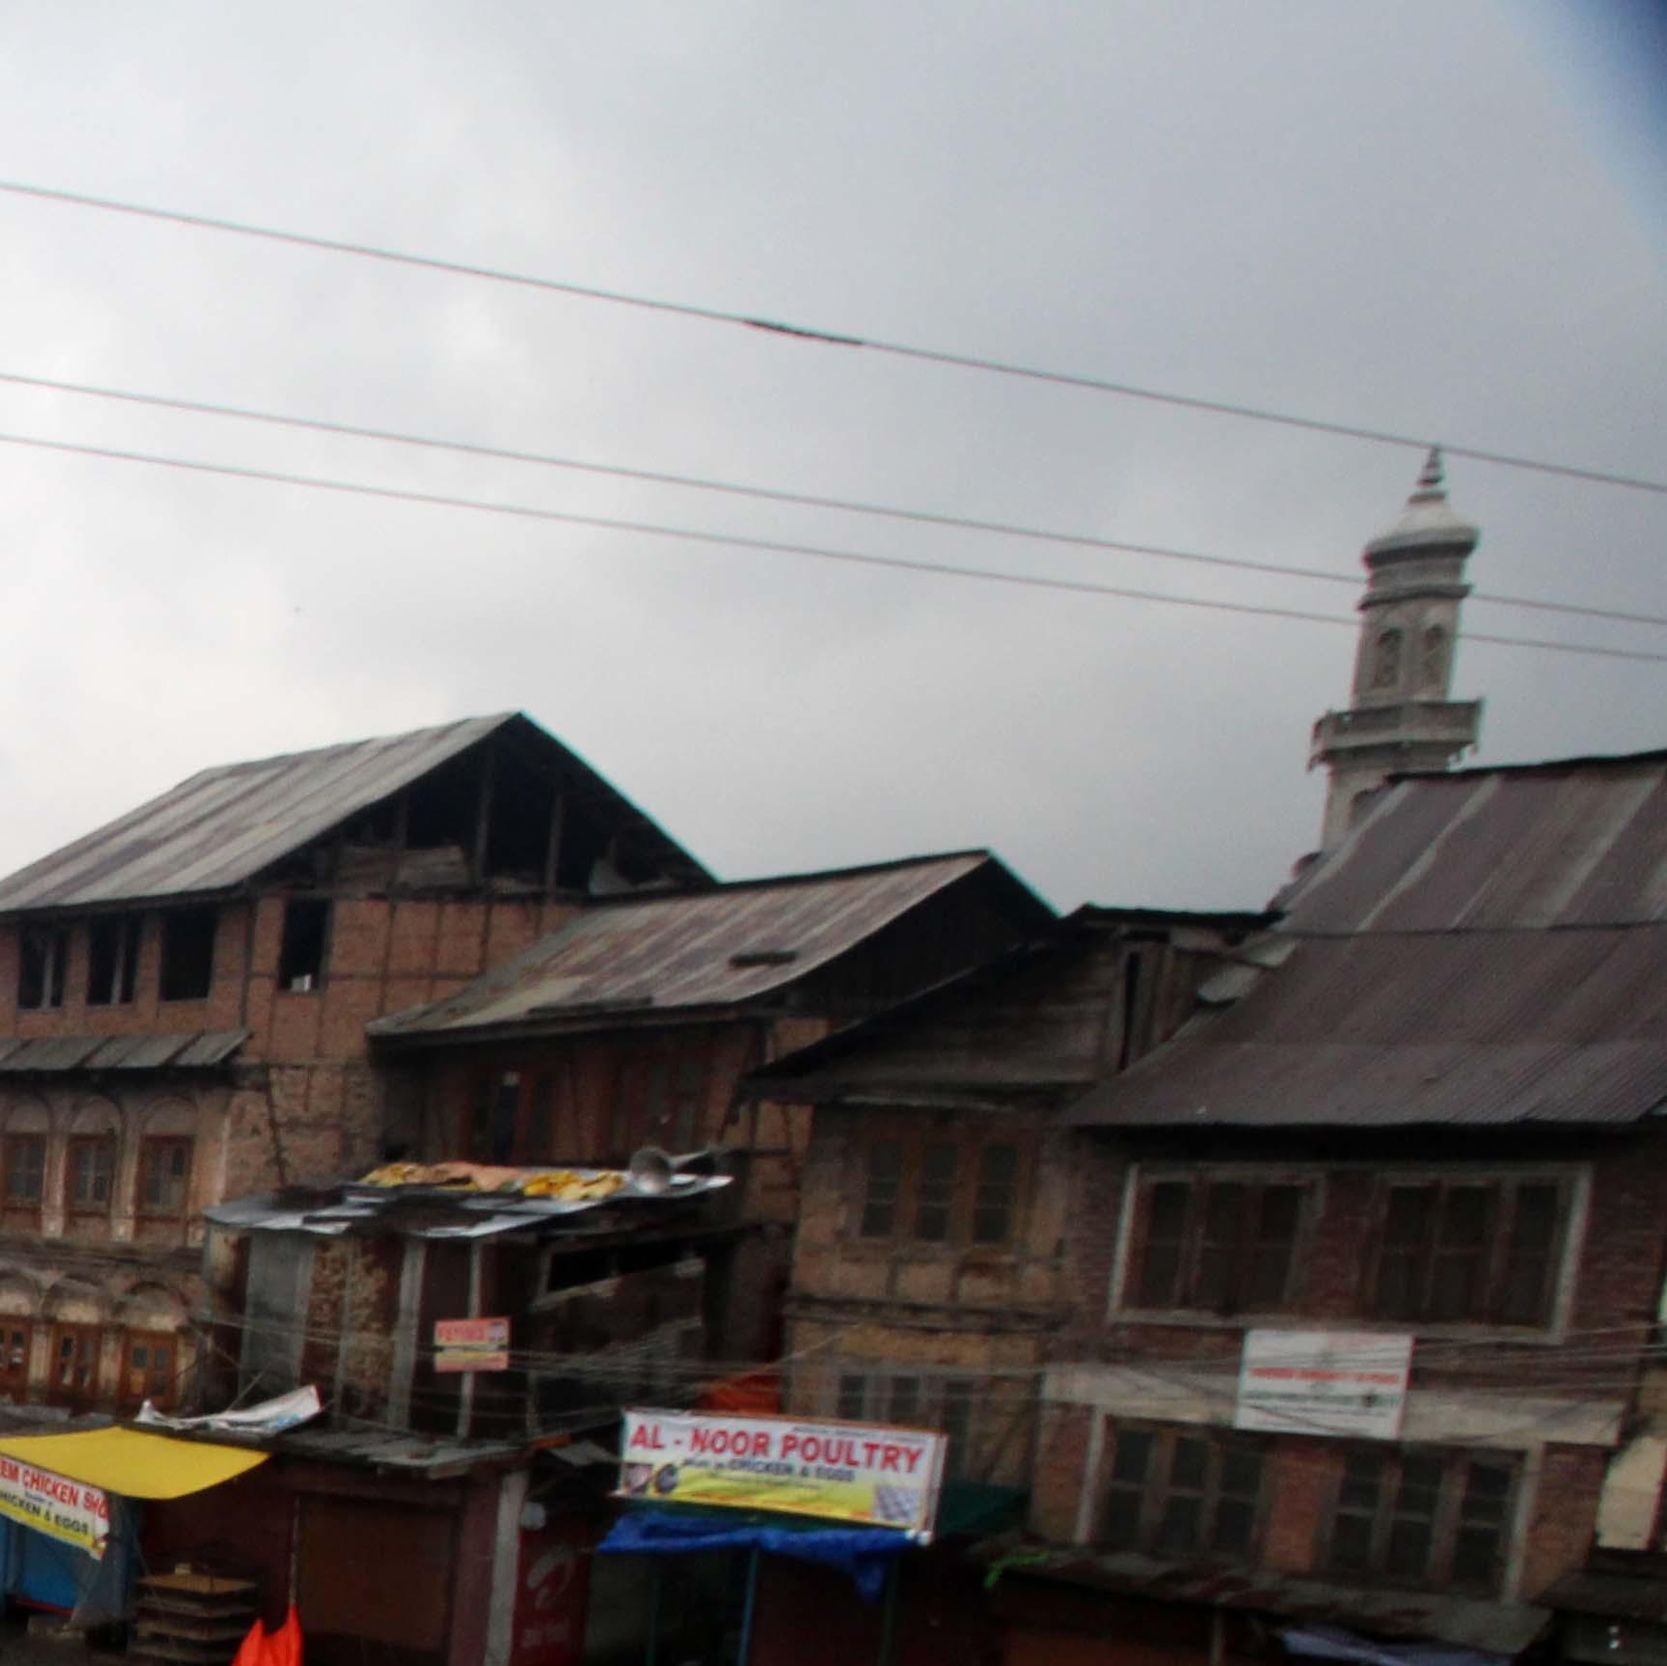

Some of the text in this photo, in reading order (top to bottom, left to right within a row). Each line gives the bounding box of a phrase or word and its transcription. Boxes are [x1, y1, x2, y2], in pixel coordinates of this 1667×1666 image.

[630, 1424, 665, 1450] AL
[690, 1427, 771, 1457] NOOR
[779, 1434, 925, 1473] POULTRY
[22, 1467, 79, 1507] CHICKEN
[54, 1514, 89, 1536] EGGS
